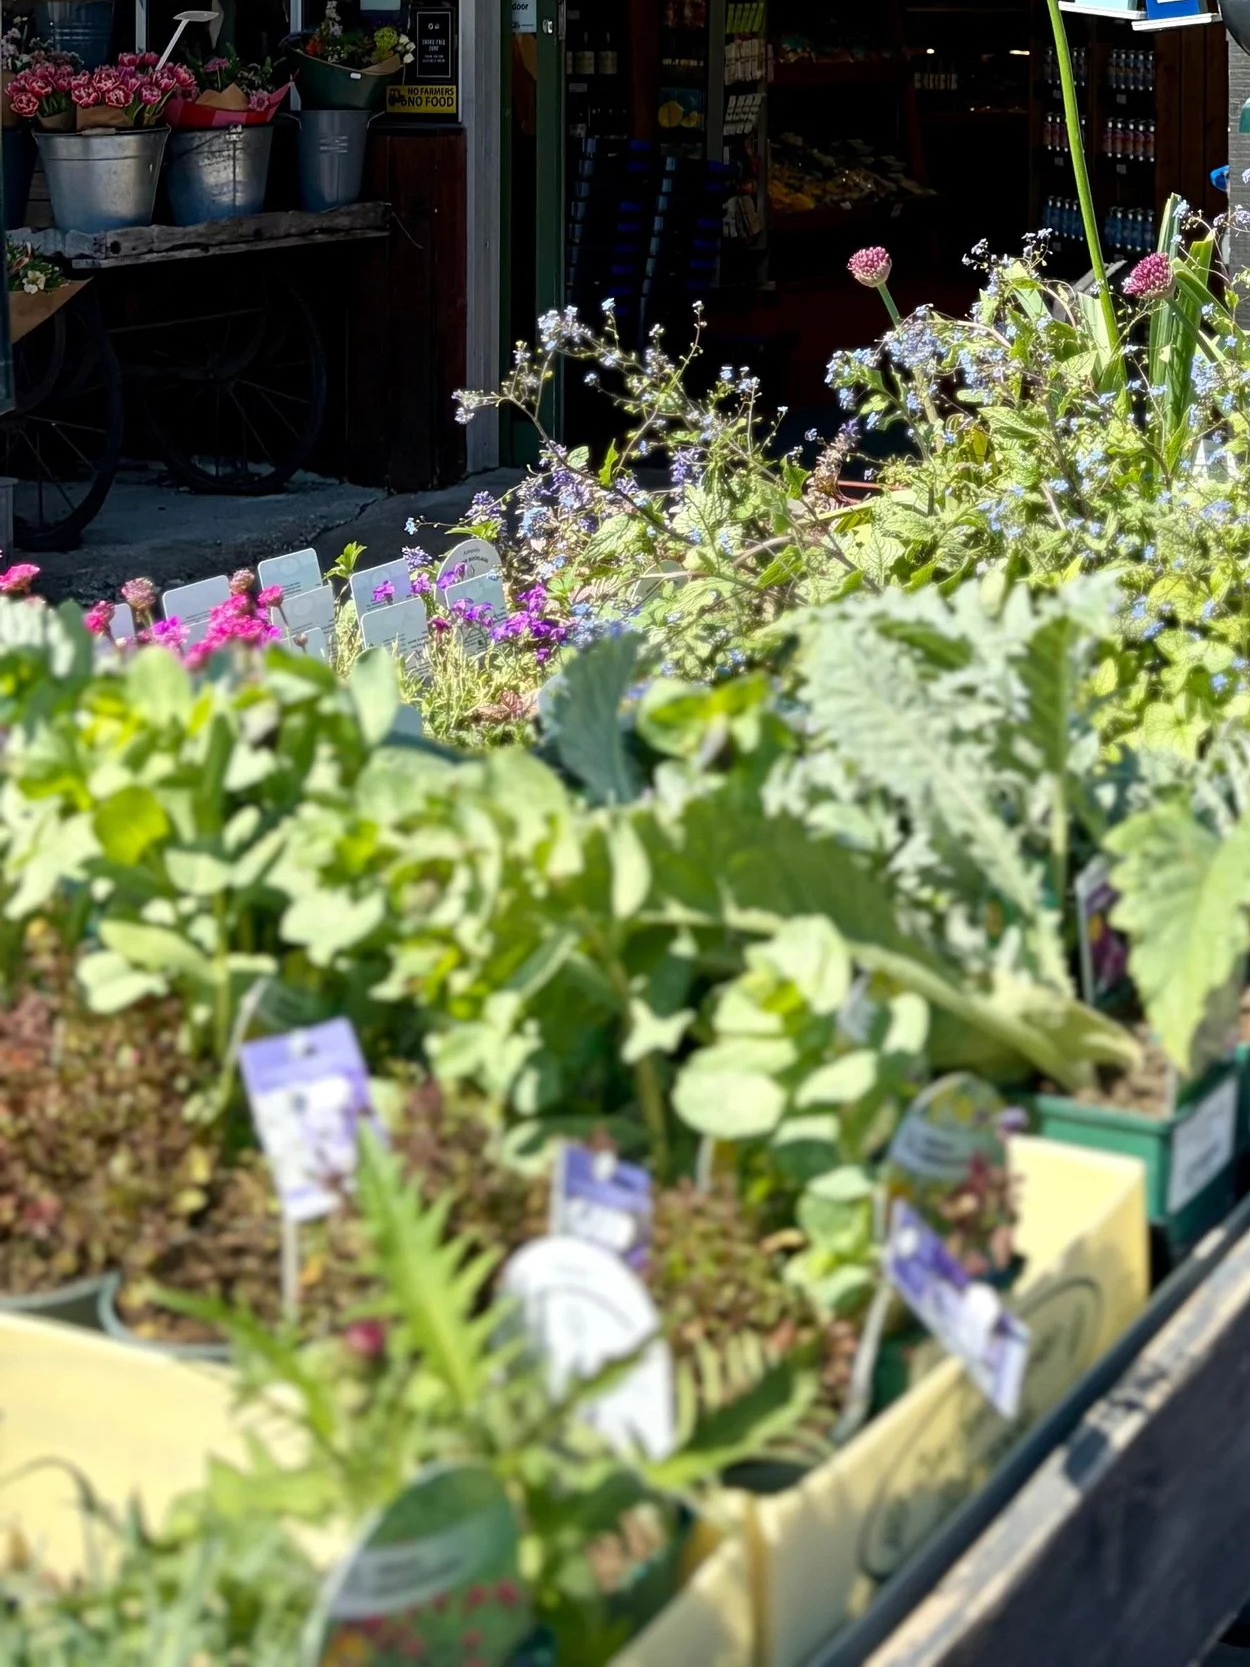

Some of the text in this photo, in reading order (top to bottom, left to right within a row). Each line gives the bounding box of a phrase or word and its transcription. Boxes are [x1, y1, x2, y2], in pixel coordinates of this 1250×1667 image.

[511, 2, 529, 11] door
[407, 87, 454, 96] NO FARMERS
[407, 96, 454, 107] NO FOOD
